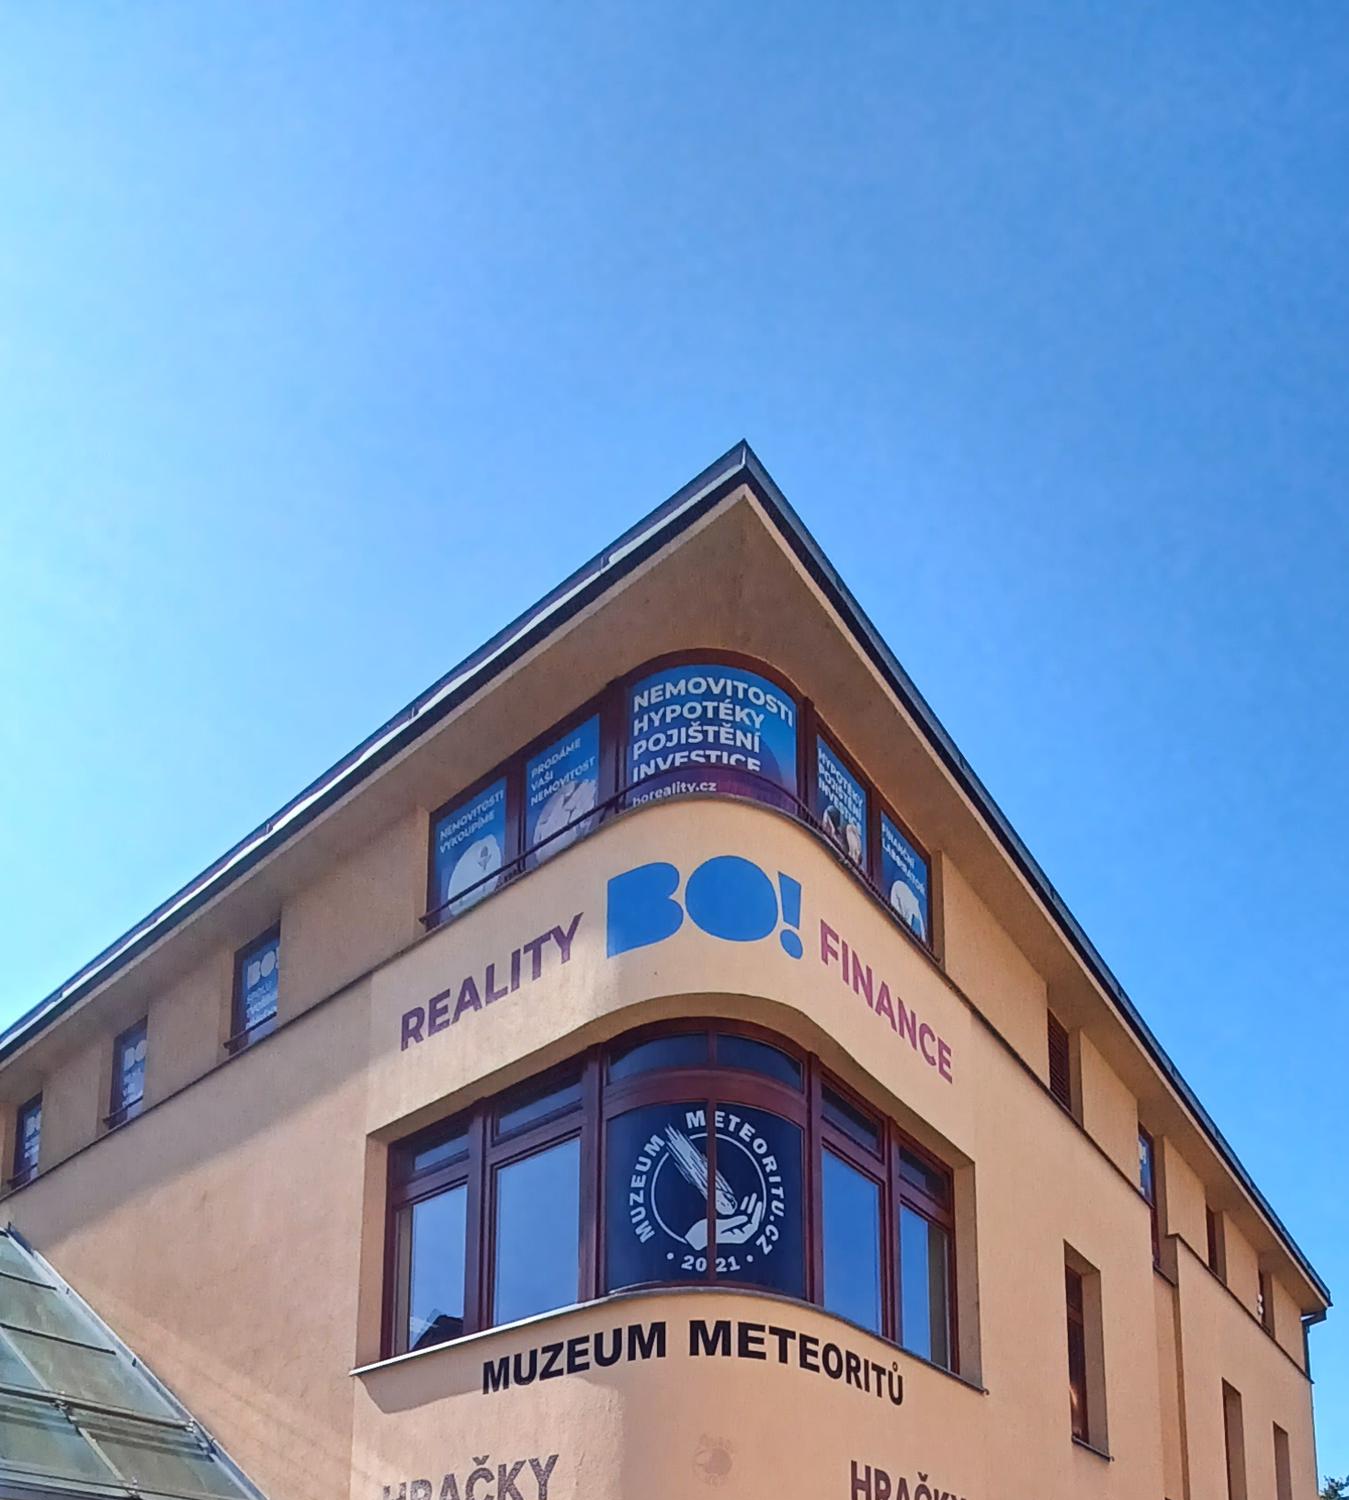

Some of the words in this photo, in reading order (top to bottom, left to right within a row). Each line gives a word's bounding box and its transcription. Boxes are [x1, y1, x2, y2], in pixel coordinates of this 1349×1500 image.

[633, 676, 794, 728] NEMOVITOSTI
[633, 698, 765, 737] HYPOTÉKY
[530, 737, 582, 778] PRODÁME
[632, 721, 761, 761] POJIŠTĚNÍ
[530, 755, 596, 807] NEMOVITOST
[439, 789, 505, 841] NEMOVITOSTI
[400, 911, 584, 1052] REALITY
[606, 854, 804, 960] BO!
[820, 917, 953, 1085] FINANCE
[629, 1133, 666, 1244] MUZEUM
[685, 1109, 786, 1255] METEORITU.CZ
[680, 1254, 741, 1273] 2021
[481, 1321, 667, 1396] MUZEUM
[688, 1318, 905, 1407] METEORITŮ
